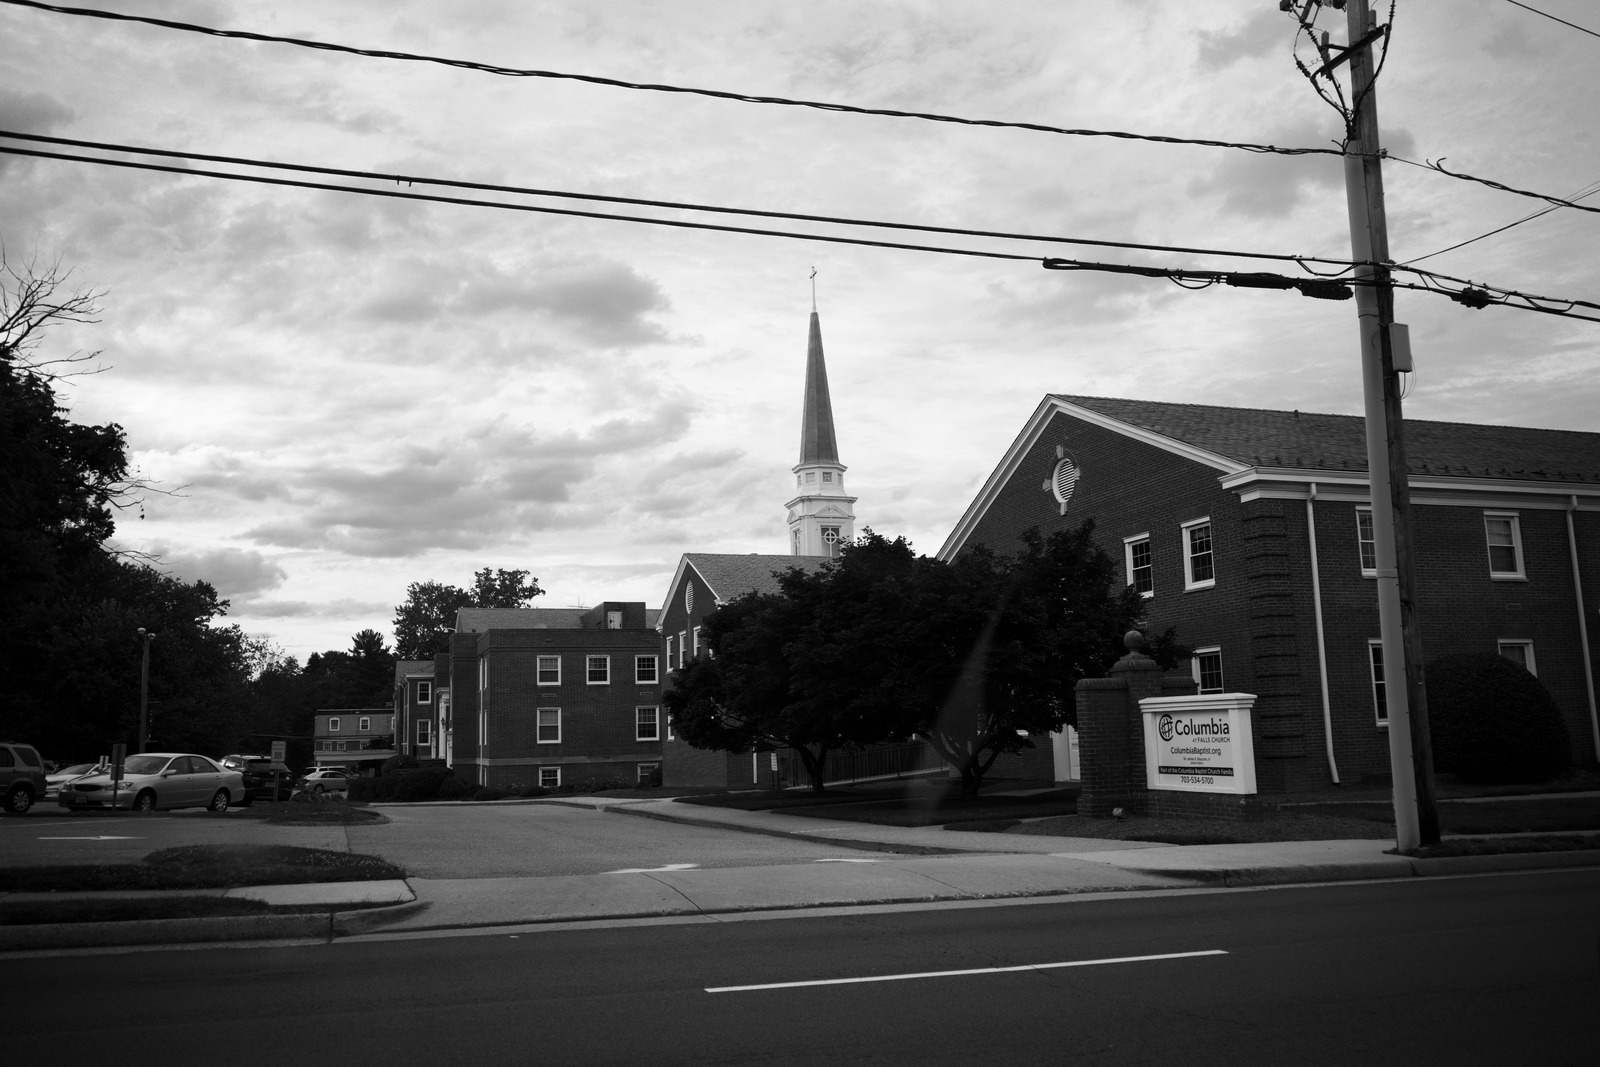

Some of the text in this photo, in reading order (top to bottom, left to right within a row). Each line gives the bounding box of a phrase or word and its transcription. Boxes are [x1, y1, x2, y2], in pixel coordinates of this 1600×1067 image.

[1175, 717, 1230, 736] Columbia
[1170, 746, 1222, 756] ColumbiaBaptist.org
[1181, 776, 1214, 785] 703-534-5700
